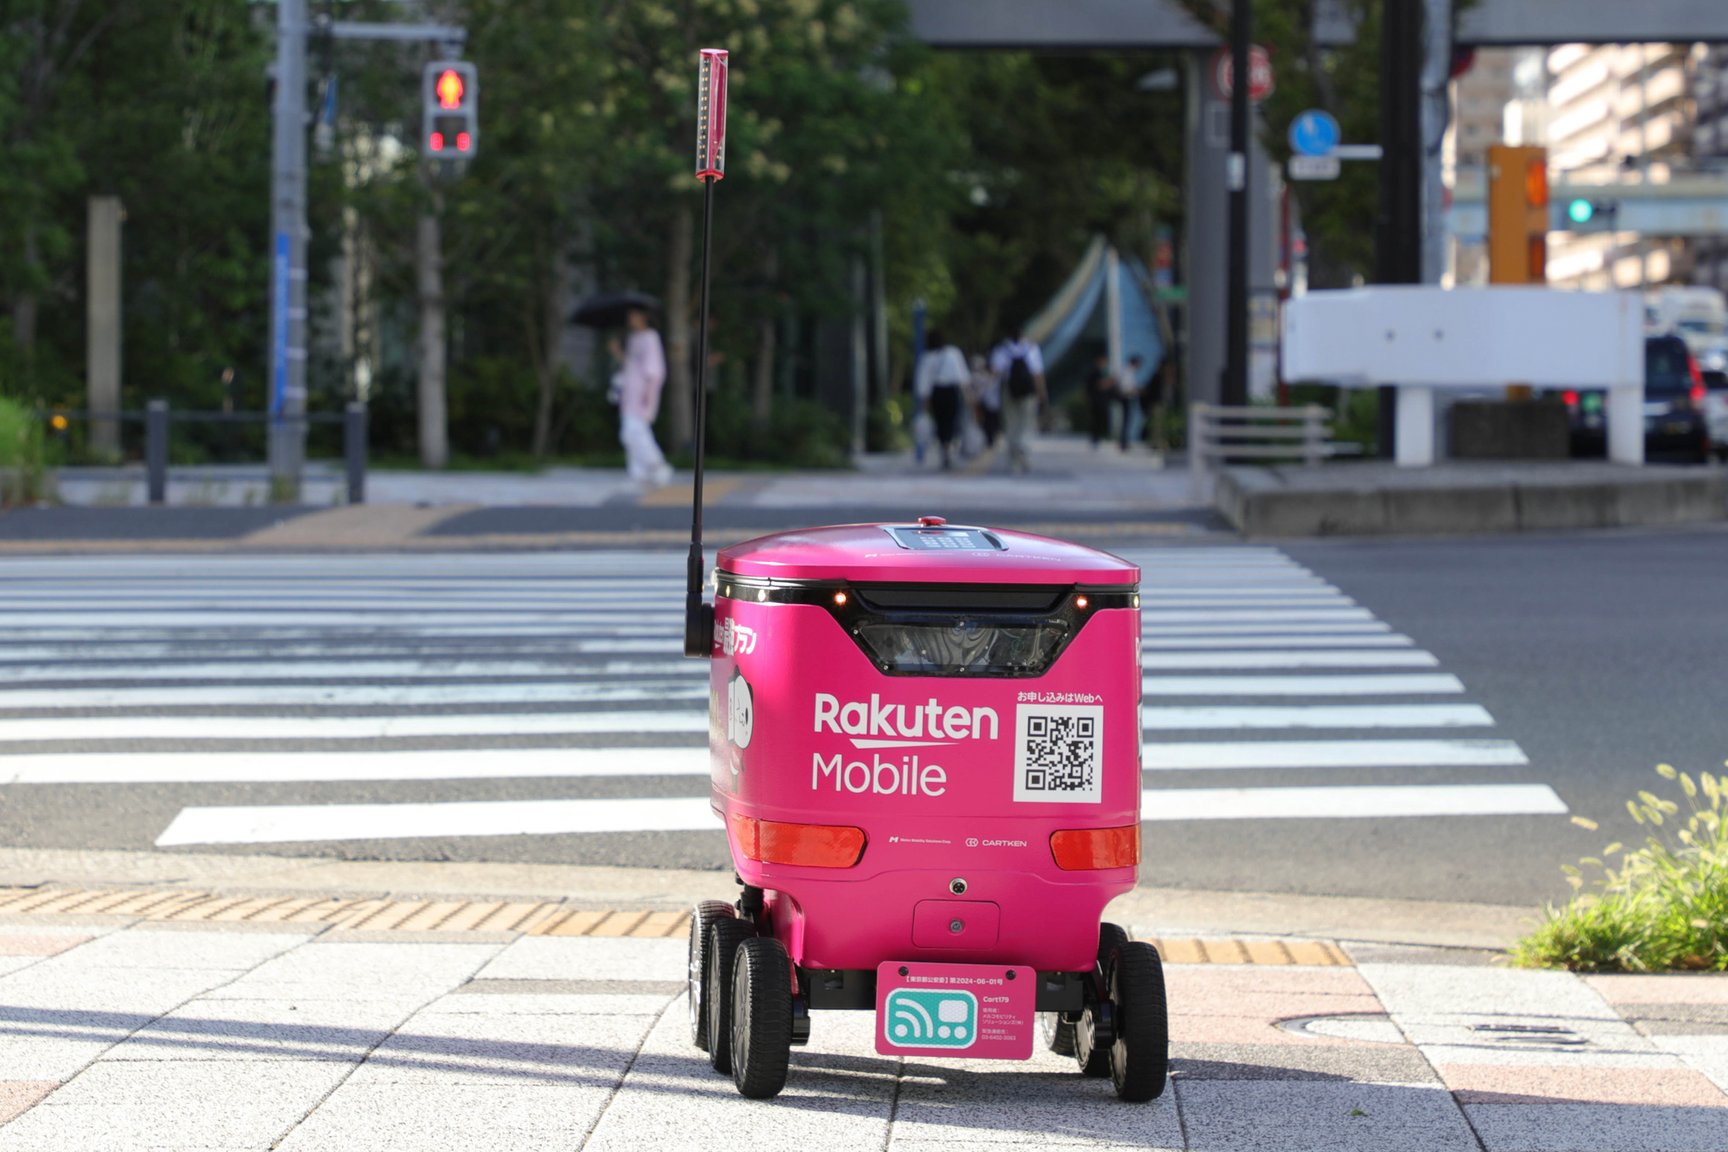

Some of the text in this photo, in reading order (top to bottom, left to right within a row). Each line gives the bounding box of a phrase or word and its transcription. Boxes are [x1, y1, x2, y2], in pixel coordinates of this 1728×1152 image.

[1017, 691, 1103, 703] お申し込みはWebへ
[814, 692, 999, 740] Rakuten
[811, 752, 947, 797] Mobile
[982, 839, 1027, 847] CARTKEN
